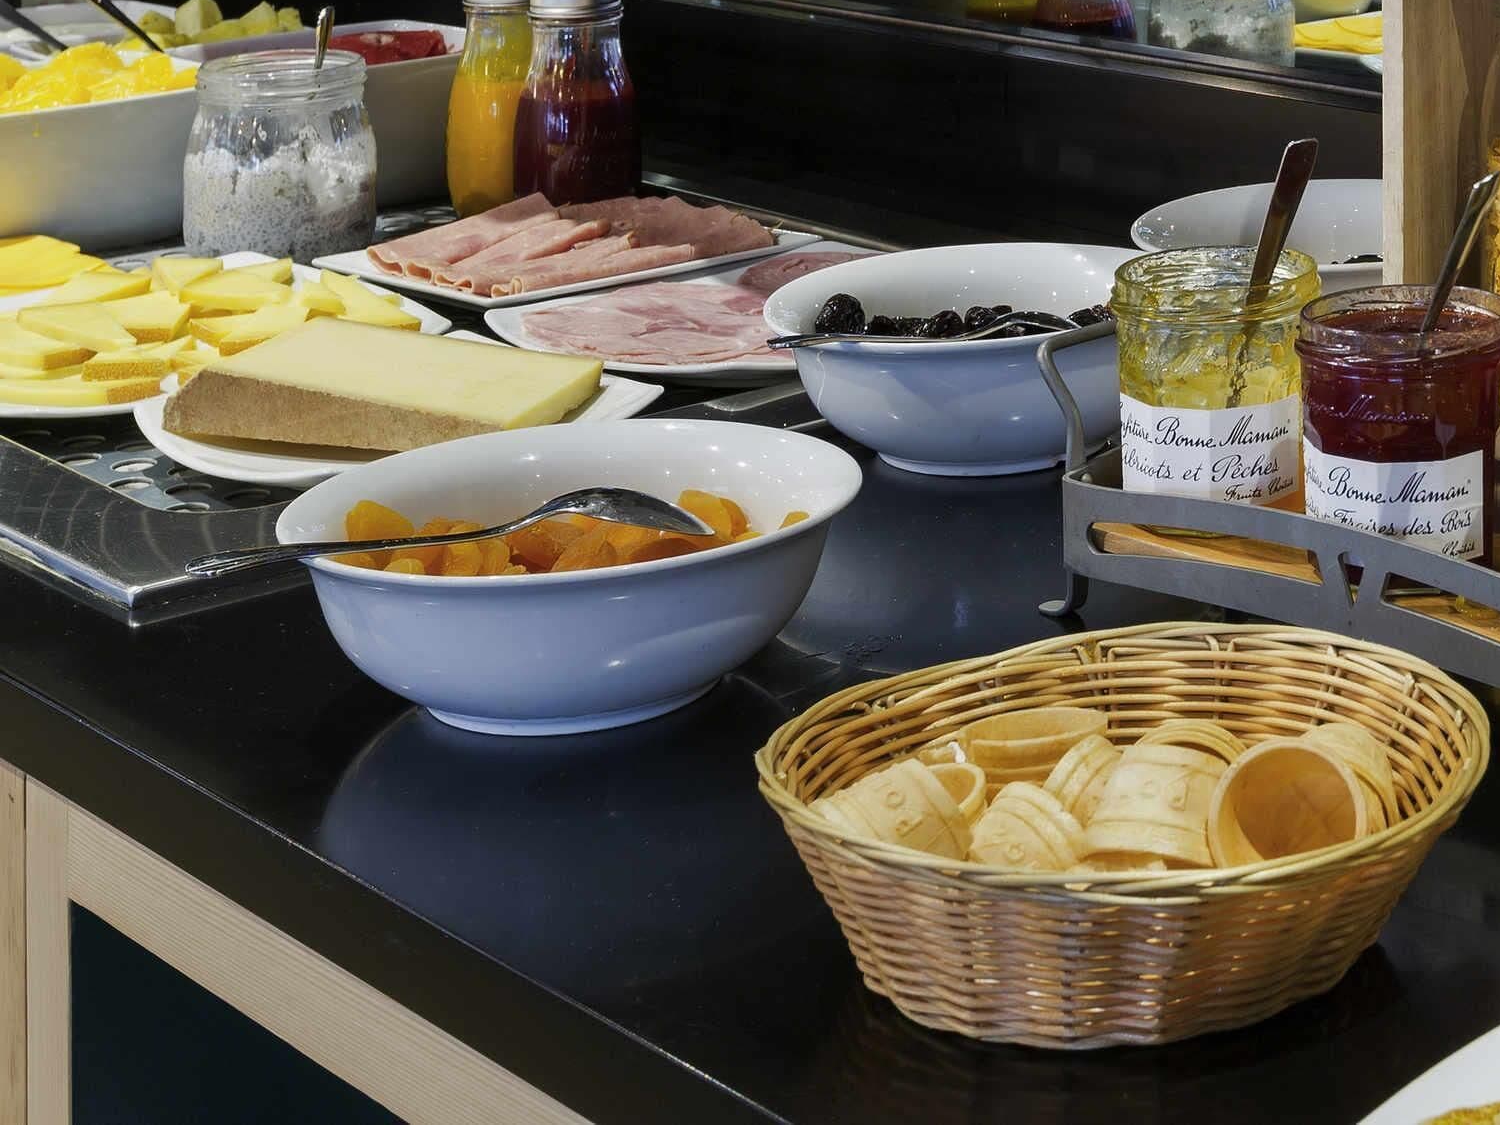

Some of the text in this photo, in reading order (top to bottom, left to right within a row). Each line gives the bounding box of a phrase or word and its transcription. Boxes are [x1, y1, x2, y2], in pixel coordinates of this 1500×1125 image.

[1155, 416, 1216, 449] Bonne
[1219, 413, 1289, 447] Maman
[1182, 465, 1202, 482] et
[1211, 454, 1280, 483] Pêches
[1223, 483, 1262, 502] Fruits
[1327, 466, 1387, 504] Bonne
[1389, 471, 1470, 504] Maman
[1403, 518, 1435, 536] des
[1439, 509, 1473, 535] Bois
